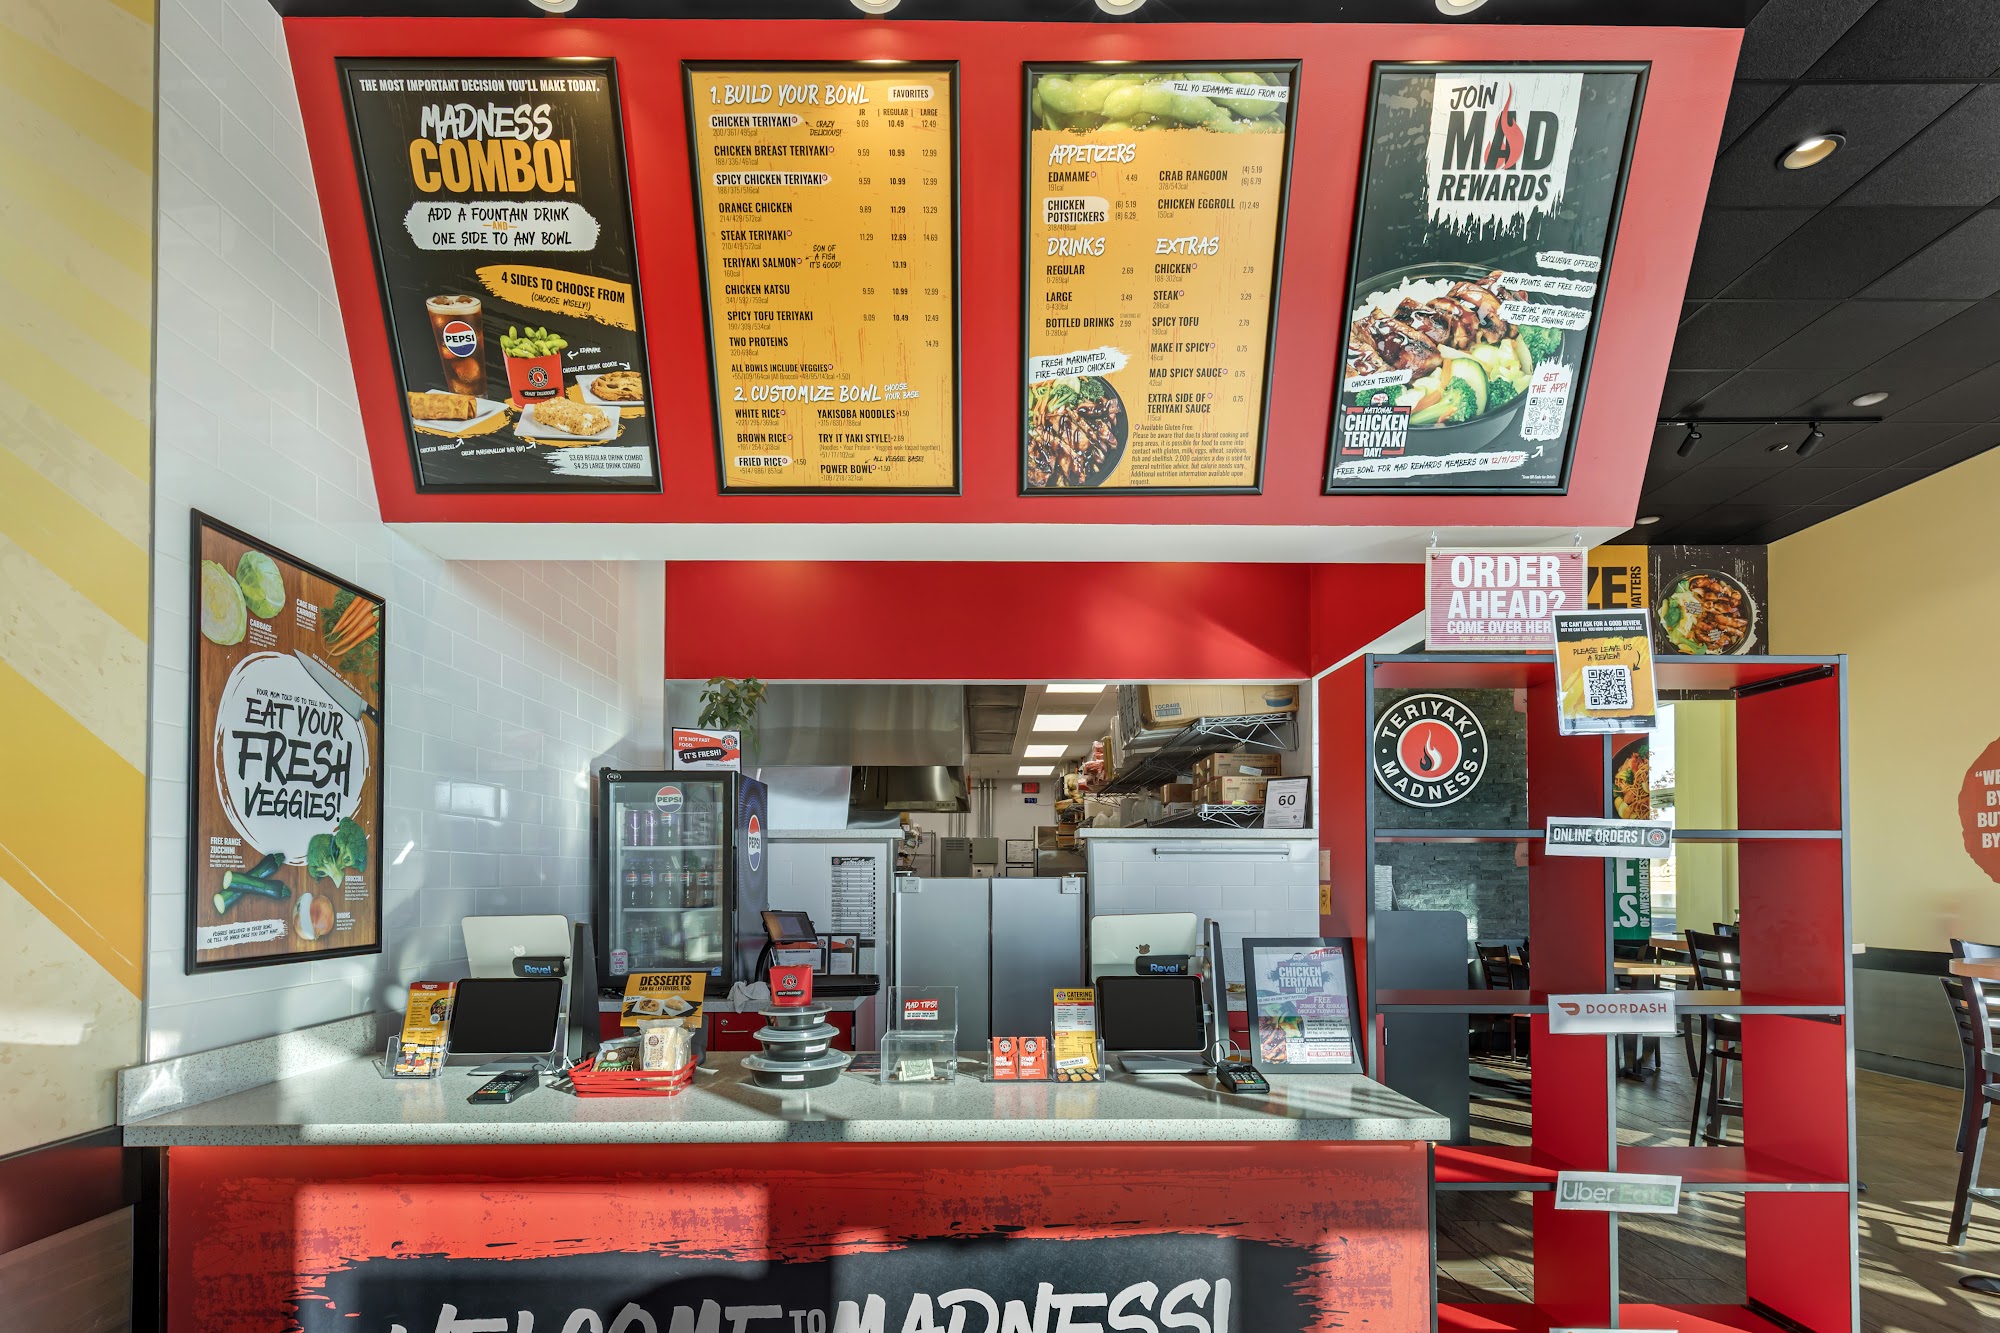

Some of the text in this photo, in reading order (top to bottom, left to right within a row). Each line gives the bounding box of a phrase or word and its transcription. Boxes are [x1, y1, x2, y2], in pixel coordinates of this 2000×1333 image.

[360, 79, 600, 92] THE MOST IMPORTANT DECISION YOU'LL MAKE TODAY.
[1174, 83, 1287, 98] TELL YO EDAMAME HELLO FROM US
[710, 83, 869, 106] 1. BUILD YOUR BOWL
[893, 90, 929, 98] FAVORITES
[1450, 82, 1498, 110] JOIN
[421, 102, 552, 144] MADNESS
[712, 116, 791, 127] CHICKEN TERIYAKI
[1442, 110, 1559, 170] MAD
[714, 145, 828, 156] CHICKEN BREAST TERIYAKI
[1048, 143, 1136, 166] APPETIZERS
[410, 139, 575, 193] COMBO!
[717, 174, 822, 185] SPICY CHICKEN TERIYAKI
[1048, 171, 1089, 182] EDAMAME
[1159, 170, 1227, 181] CRAB RANGOON
[1437, 174, 1551, 201] REWARDS
[719, 202, 792, 213] ORANGE CHICKEN
[1048, 200, 1085, 211] CHICKEN
[1158, 198, 1235, 210] CHICKEN EGGROLL
[428, 207, 569, 222] ADD A FOUNTAIN DRINK
[1048, 211, 1104, 222] POTSTICKERS
[492, 221, 508, 230] AND
[433, 231, 571, 247] ONE SIDE TO ANY BOWL
[721, 230, 786, 241] STEAK TERIYAKI
[1047, 237, 1106, 256] DRINKS
[1155, 236, 1219, 256] EXTRAS
[723, 258, 796, 268] TERIYAKI SALMON
[892, 261, 906, 269] 13.19
[1540, 255, 1598, 269] EXCLUSIVE OFFERS!
[1047, 265, 1085, 275] REGULAR
[502, 272, 625, 303] 4 SIDES TO CHOOSE FROM
[726, 285, 790, 295] CHICKEN KATSU
[1046, 292, 1072, 302] LARGE
[1154, 290, 1178, 300] STEAK
[531, 292, 591, 311] (CHOOSE WISELY!)
[728, 311, 813, 321] SPICY TOFU TERIYAKI
[445, 334, 475, 343] PEPSI
[1543, 372, 1559, 382] GET
[1532, 382, 1568, 393] THE APP!
[734, 384, 881, 404] 2. CUSTOMIZE BOWL
[735, 409, 780, 418] WHITE RICE
[818, 409, 895, 419] YAKISOBA NOODLES
[1345, 414, 1408, 431] CHICKEN
[1344, 432, 1407, 448] TERIYAKI
[1363, 448, 1382, 457] DAY!
[739, 457, 782, 467] FRIED RICE
[1451, 556, 1561, 588] ORDER
[1448, 590, 1566, 619] AHEAD?
[250, 619, 272, 632] CABBAGE
[1447, 621, 1551, 634] COME OVER HER
[1573, 647, 1598, 655] PLEASE
[245, 698, 343, 741] EAT YOUR
[1381, 701, 1476, 739] TERIYAKI
[698, 749, 721, 758] FRESH!
[232, 730, 352, 797] FRESH
[1382, 759, 1478, 800] MADNESS
[245, 782, 341, 822] VEGGIES!
[1278, 795, 1296, 806] 60
[1553, 827, 1638, 844] ONLINE ORDERS
[210, 837, 241, 846] FREE RANGE
[749, 837, 760, 850] PEPSI
[210, 846, 235, 854] ZUCCHINI
[1640, 917, 1650, 927] OF
[524, 964, 551, 974] Revel
[1151, 963, 1178, 973] Revel
[1279, 967, 1321, 977] CHICKEN
[640, 975, 692, 986] DESSERTS
[1280, 977, 1322, 987] TERIYAKI
[905, 1000, 937, 1009] MAD TIPS!
[1586, 1002, 1667, 1014] DOORDASH
[1563, 1181, 1675, 1204] Uber Eats
